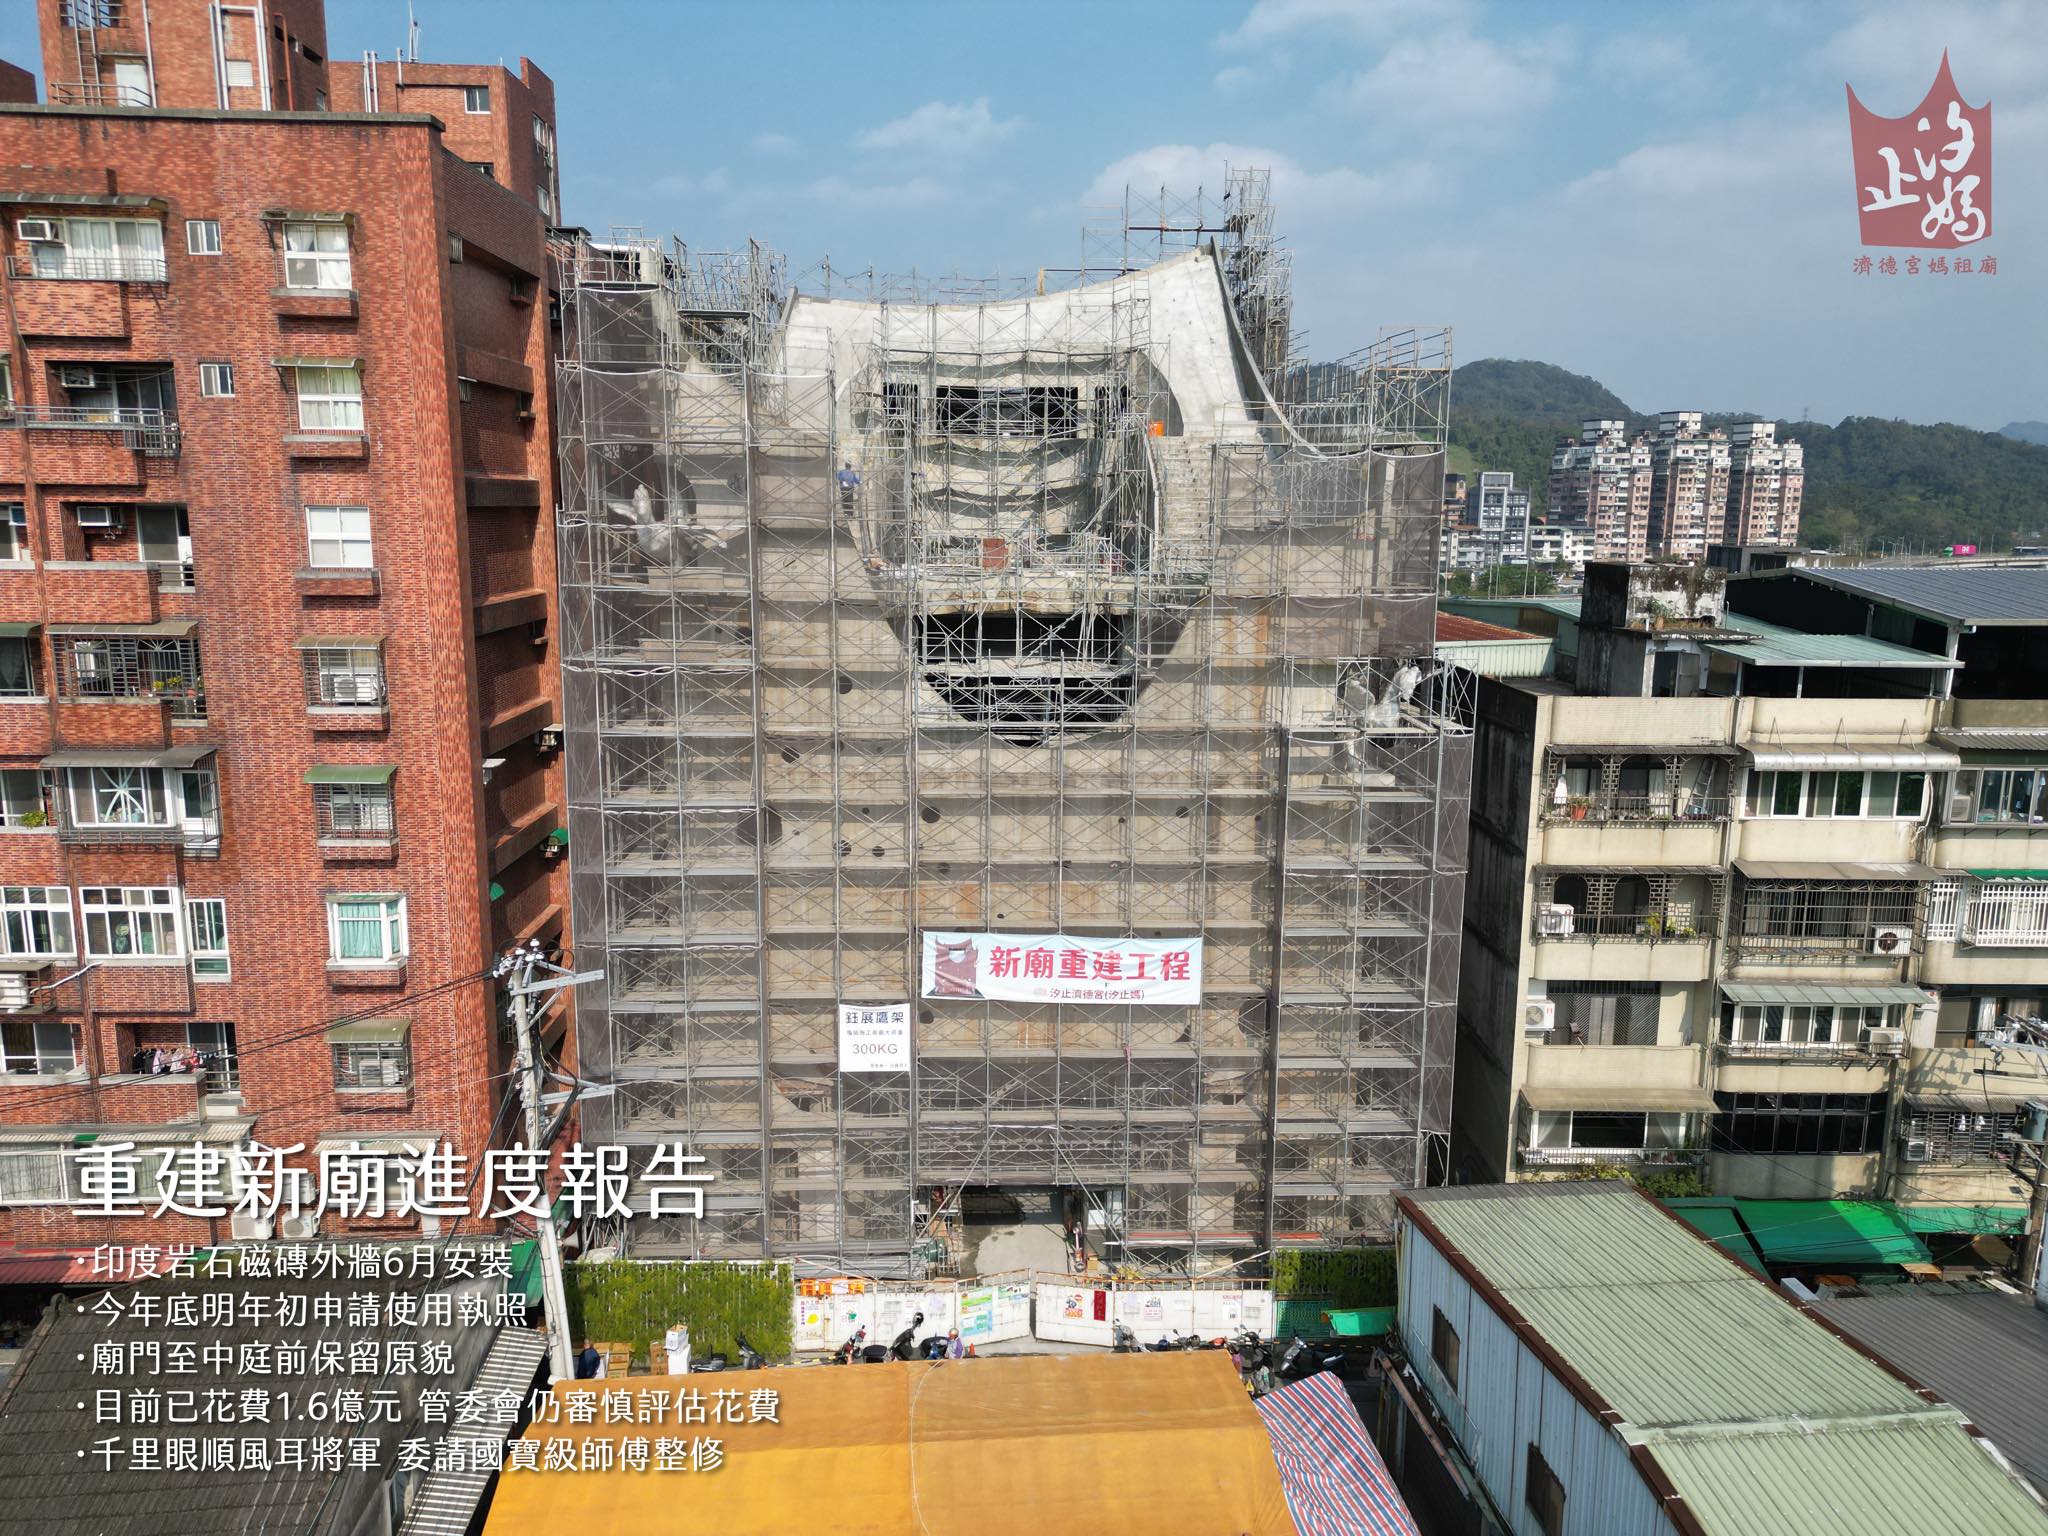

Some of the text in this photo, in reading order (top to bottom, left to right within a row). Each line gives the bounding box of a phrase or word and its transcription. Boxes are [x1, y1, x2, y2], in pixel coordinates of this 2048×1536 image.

[989, 945, 1190, 981] 新廟重建工程
[846, 1011, 904, 1024] 鈺展鷹架
[852, 1043, 898, 1055] 300KG
